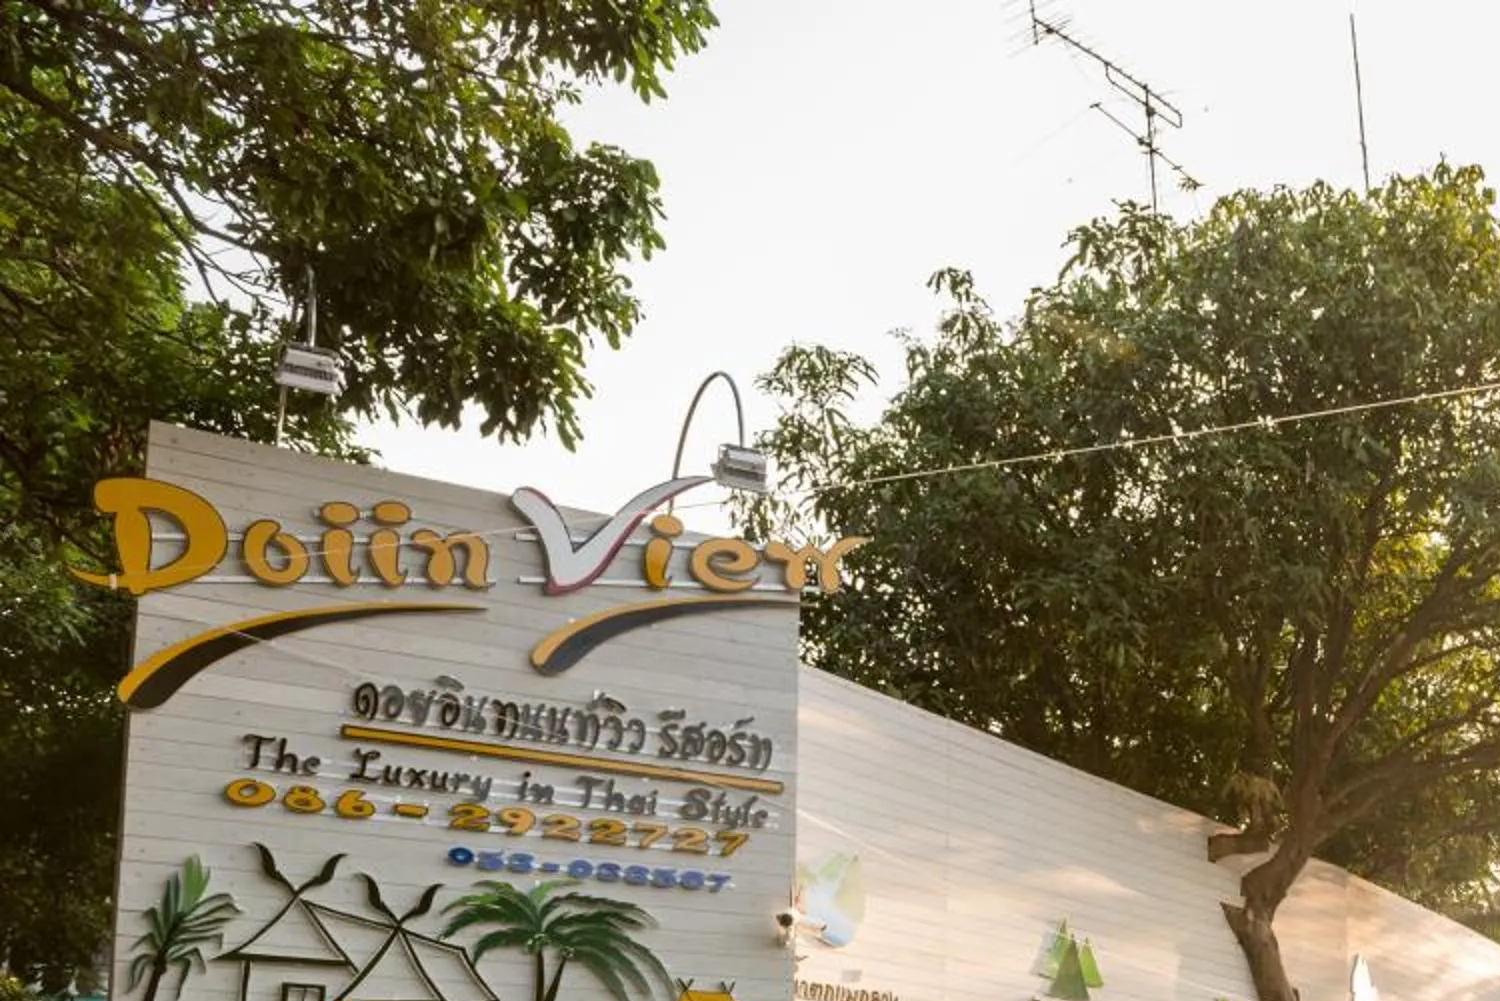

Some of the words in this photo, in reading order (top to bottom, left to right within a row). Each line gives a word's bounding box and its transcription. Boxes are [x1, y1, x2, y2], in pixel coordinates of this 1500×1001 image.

[67, 477, 490, 595] Doiin
[511, 475, 873, 596] View
[242, 733, 321, 776] The
[349, 747, 493, 801] Luxury
[518, 771, 555, 804] in
[576, 774, 659, 817] Thai
[679, 787, 769, 830] Style
